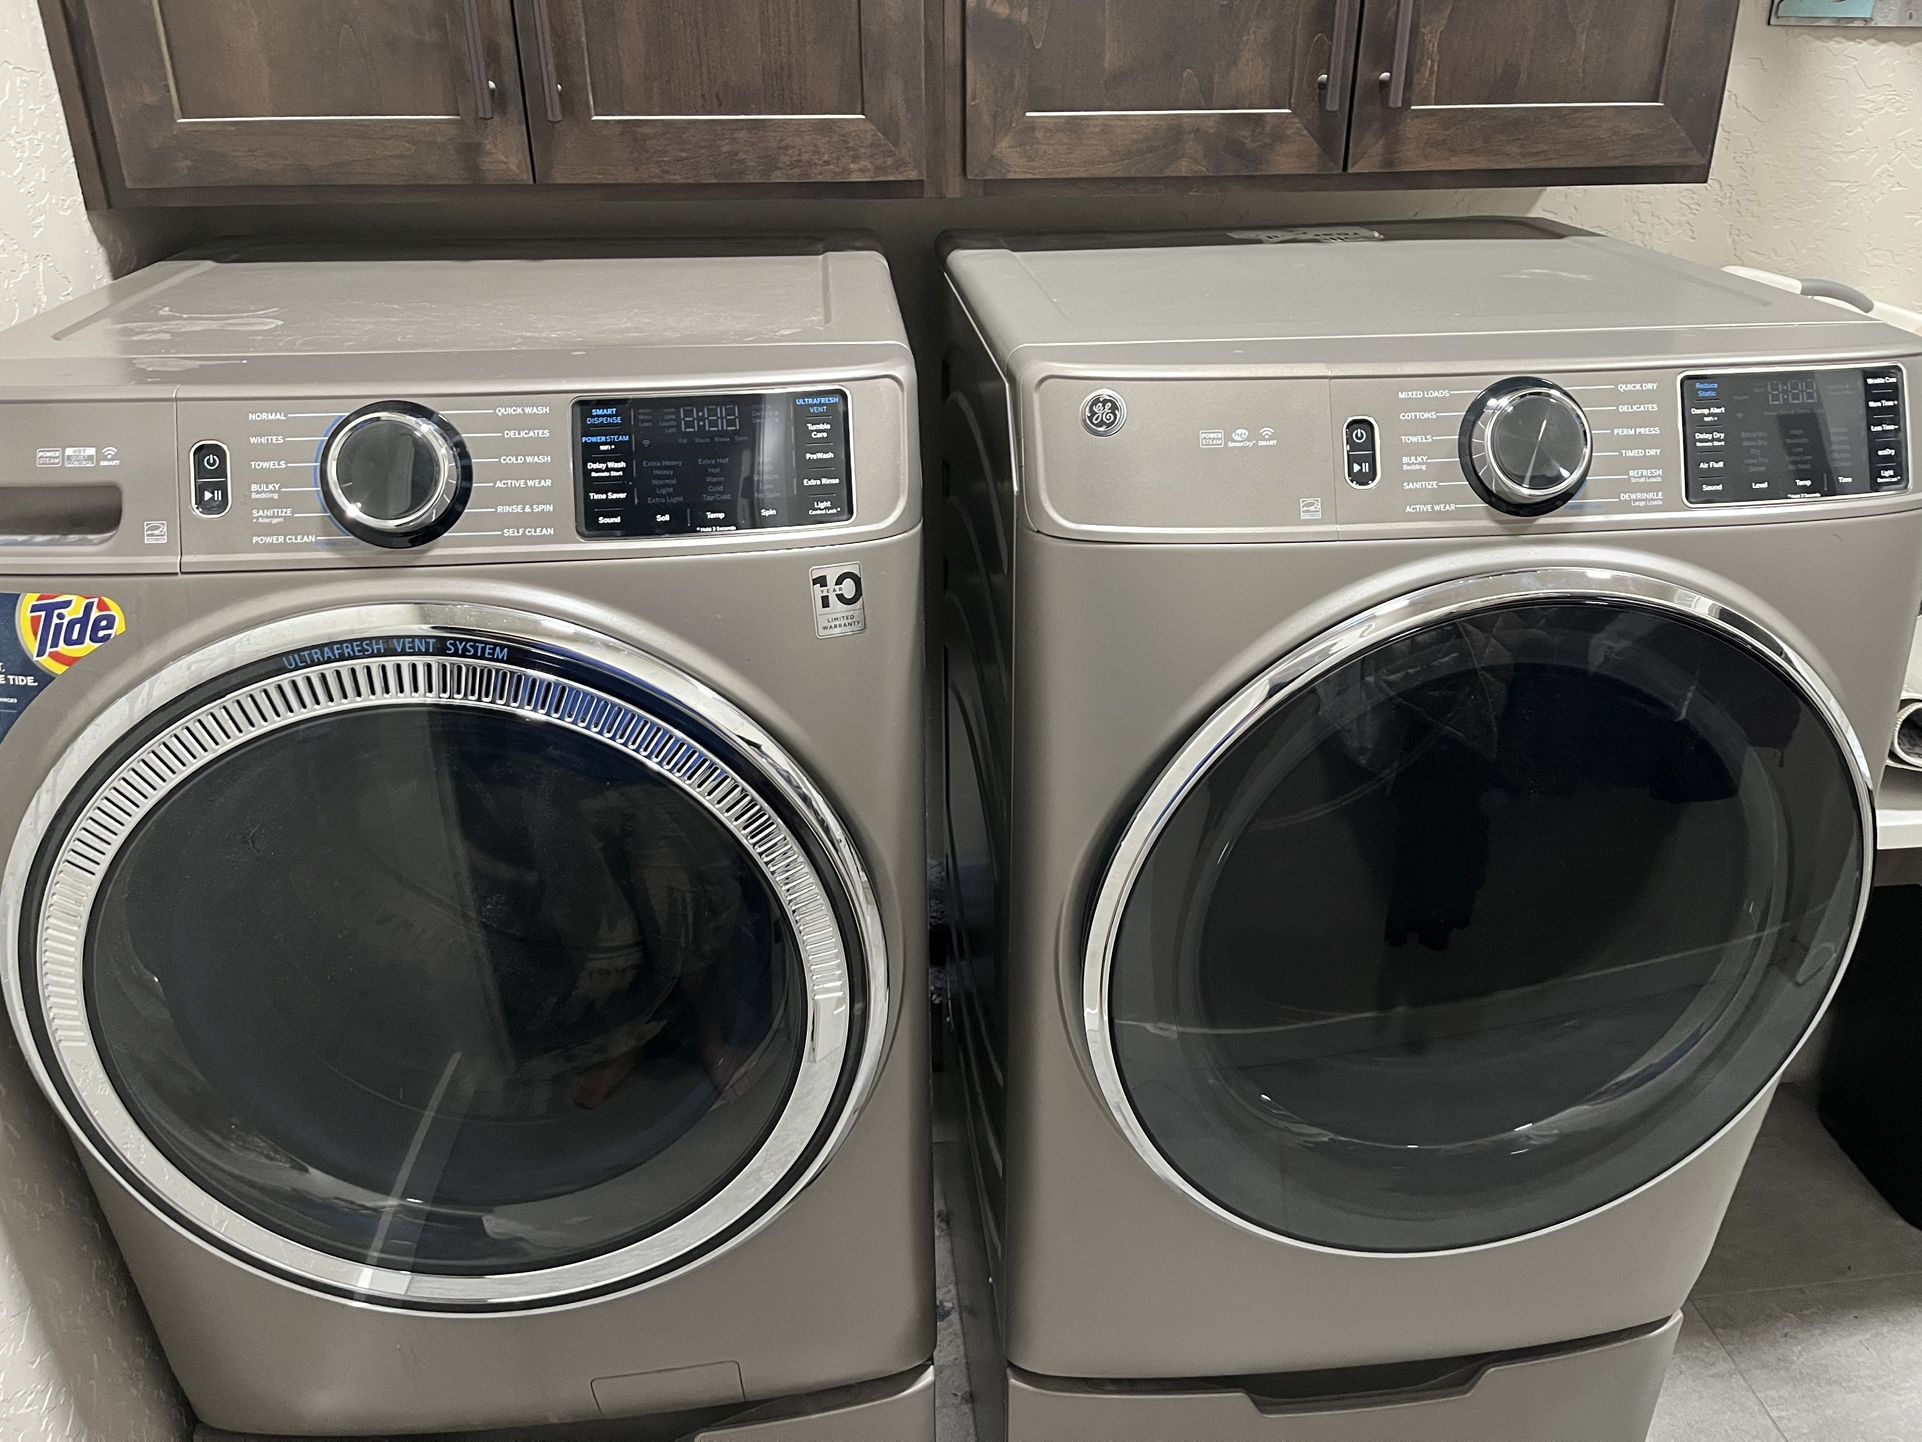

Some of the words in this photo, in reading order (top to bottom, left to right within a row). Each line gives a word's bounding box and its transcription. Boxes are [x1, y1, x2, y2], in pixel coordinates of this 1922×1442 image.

[1618, 383, 1641, 392] QUICK
[1642, 382, 1658, 390] DRY
[1398, 391, 1423, 399] MIXED
[1424, 390, 1450, 398] LOADS
[796, 397, 839, 405] ULTRAFRESH
[495, 406, 523, 416] QUICK
[524, 406, 550, 414] WASH
[591, 408, 617, 416] SMART
[1618, 403, 1658, 412] DELICATES
[248, 412, 287, 421] NORMAL
[1400, 411, 1437, 420] COTTONS
[586, 416, 622, 425] DISPENSE
[504, 429, 550, 438] DELICATES
[811, 431, 828, 439] Care
[1613, 428, 1635, 436] PERM
[1636, 427, 1660, 435] PRESS
[1713, 432, 1725, 440] Dry
[249, 435, 284, 444] WHITES
[581, 435, 606, 443] POWER
[1400, 435, 1433, 443] TOWELS
[1645, 448, 1661, 456] DRY
[501, 455, 525, 464] COLD
[525, 455, 551, 463] WASH
[1402, 456, 1428, 464] BULKY
[250, 460, 287, 469] TOWELS
[587, 462, 607, 470] Delay
[607, 461, 627, 469] Wash
[1628, 468, 1663, 477] REFRESH
[495, 479, 526, 488] ACTIVE
[526, 479, 552, 487] WEAR
[803, 478, 821, 486] Extra
[1403, 481, 1438, 490] SANITIZE
[251, 483, 280, 492] BULKY
[251, 492, 279, 500] Bedding
[588, 492, 607, 500] Time
[607, 491, 628, 499] Saver
[1620, 491, 1664, 501] DEWRINKLE
[497, 504, 523, 513] RINSE
[524, 504, 532, 512] &
[532, 503, 554, 512] SPIN
[813, 500, 832, 509] Light
[1405, 504, 1433, 513] ACTIVE
[1433, 503, 1456, 511] WEAR
[252, 508, 293, 517] SANITIZE
[705, 511, 725, 520] Temp
[760, 508, 777, 517] Spin
[598, 516, 621, 524] Sound
[656, 514, 670, 522] Soil
[503, 528, 525, 537] SELF
[525, 527, 554, 536] CLEAN
[252, 535, 284, 545] POWER
[285, 534, 316, 544] CLEAN
[811, 571, 863, 609] 10
[827, 614, 855, 623] LIMITED
[29, 598, 118, 660] Tide
[822, 620, 861, 631] WARRANTY
[282, 638, 385, 669] ULTRAFRESH
[393, 638, 437, 653] VENT
[445, 639, 509, 661] SYSTEM
[7, 674, 38, 686] TIDE.
